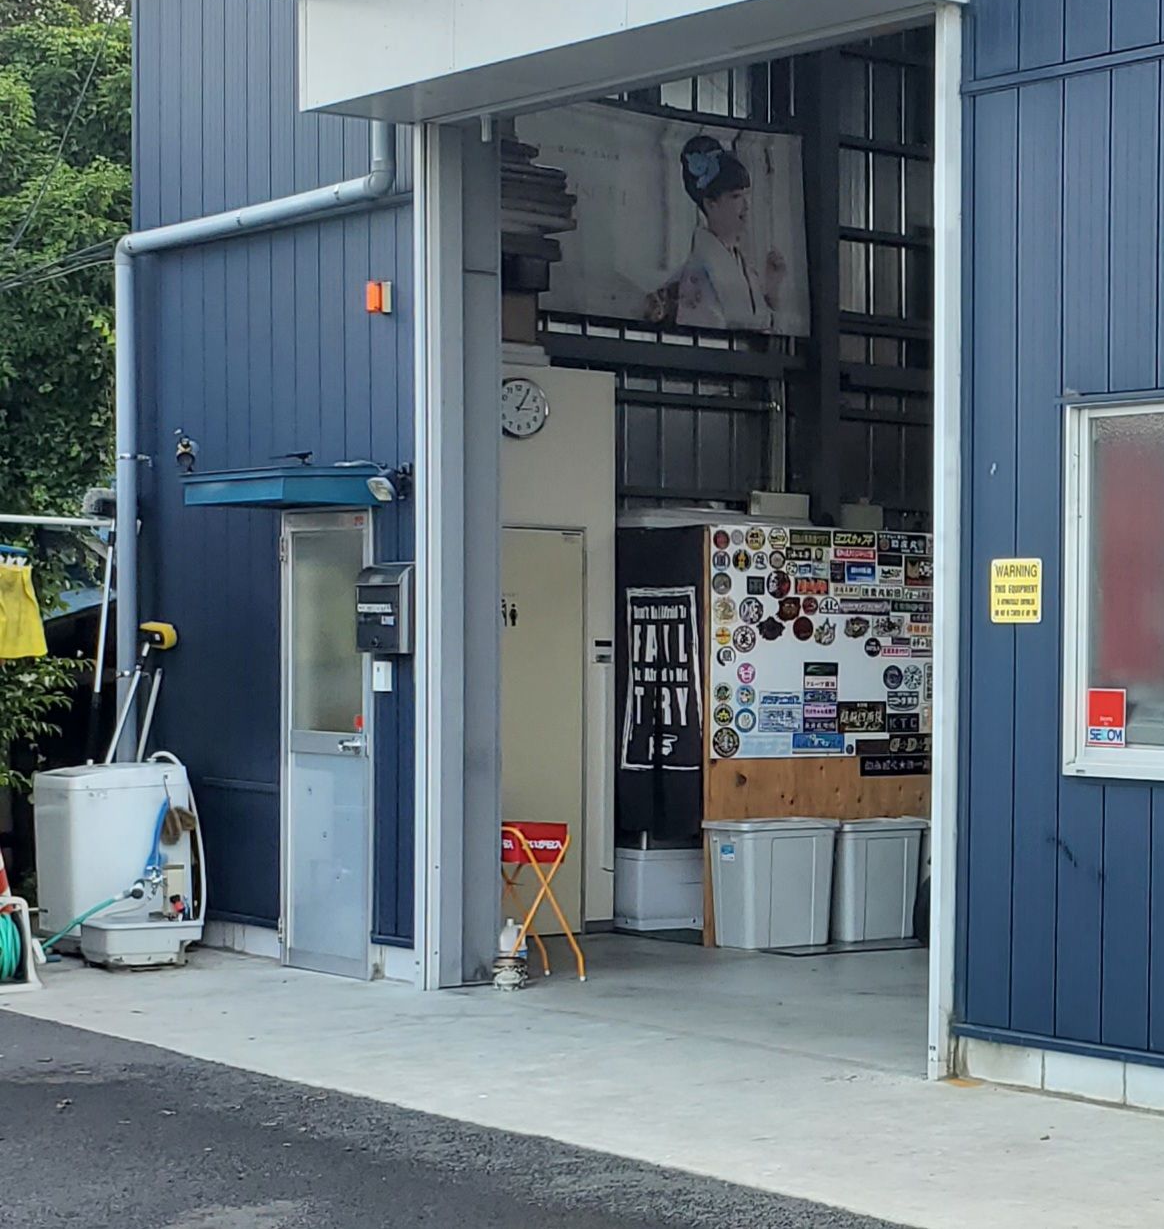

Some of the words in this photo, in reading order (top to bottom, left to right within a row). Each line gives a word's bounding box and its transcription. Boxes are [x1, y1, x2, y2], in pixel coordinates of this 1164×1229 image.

[995, 564, 1038, 578] WARNING
[633, 623, 688, 663] FAIL
[634, 686, 689, 726] TRY
[889, 717, 918, 729] KTC
[1089, 728, 1123, 742] SECOM
